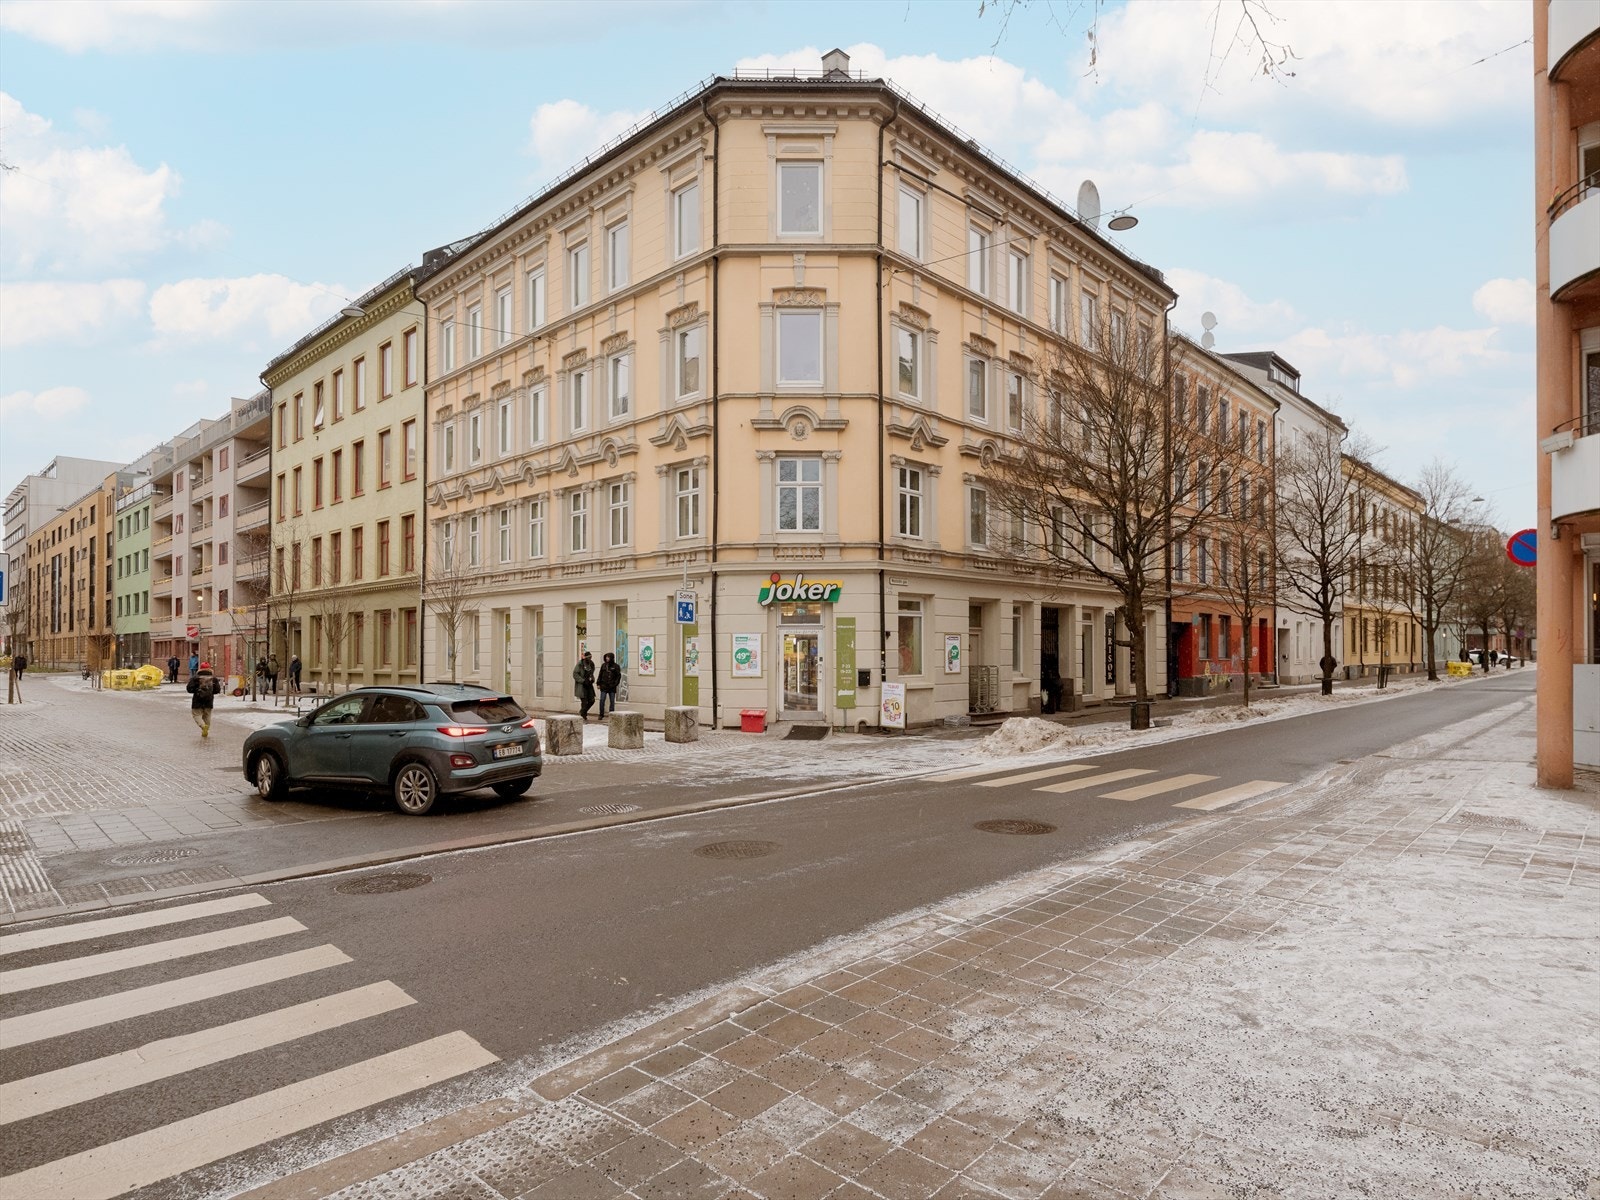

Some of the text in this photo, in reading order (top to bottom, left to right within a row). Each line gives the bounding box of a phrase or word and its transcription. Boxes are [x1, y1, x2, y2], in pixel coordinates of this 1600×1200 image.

[760, 573, 838, 606] joker
[679, 592, 693, 600] Sone
[891, 702, 900, 710] 10
